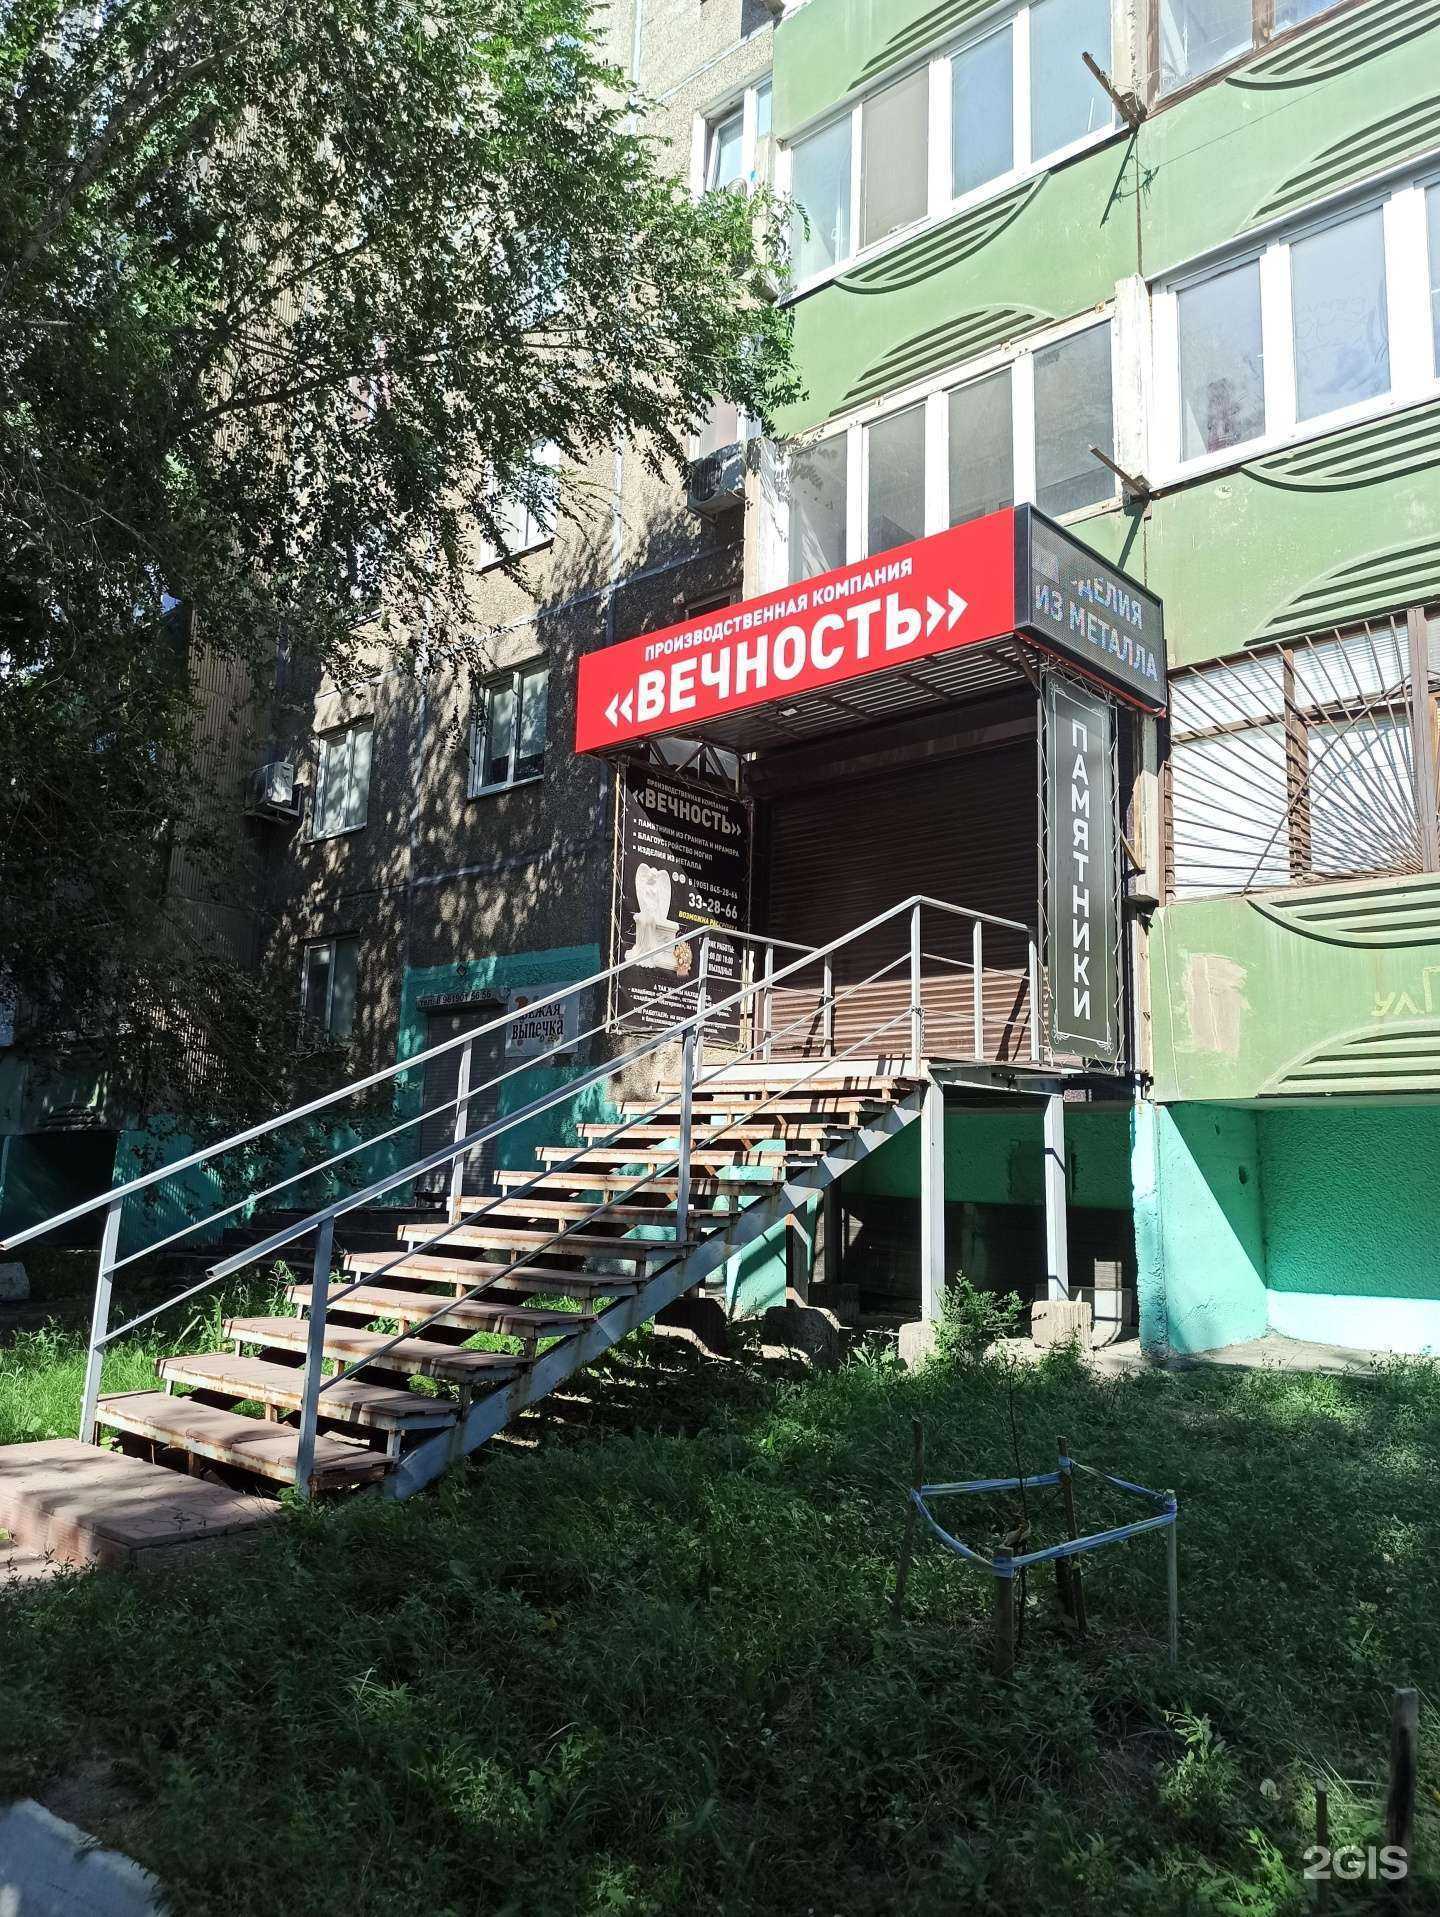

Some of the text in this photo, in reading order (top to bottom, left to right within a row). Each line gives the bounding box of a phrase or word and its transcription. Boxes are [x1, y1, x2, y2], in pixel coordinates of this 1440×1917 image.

[645, 557, 913, 662] ПРОИЗВОДСТВЕННАЯ КОМПАНИЯ
[1035, 585, 1158, 683] ИЗ МЕТАЛЛА
[604, 588, 969, 728] «ВЕЧНОСТЬ»
[632, 787, 742, 836] «ВЕЧНОСТЬ»
[646, 778, 729, 813] ПРОИЗВОДСТВЕННАЯ КОМПАНИЯ
[637, 832, 713, 861] БЛАГОУСТРОЙСТВО МОГИЛ
[638, 819, 675, 836] ПАМЯТНИКИ
[684, 833, 708, 848] ГРАНИТА
[637, 845, 667, 859] ИЗДЕЛИЯ
[675, 857, 702, 871] МЕТАЛЛА
[1071, 718, 1091, 1021] ПАМЯТНИКИ
[678, 910, 709, 925] ВОЗМОЖНА
[688, 892, 738, 919] 33-28-66
